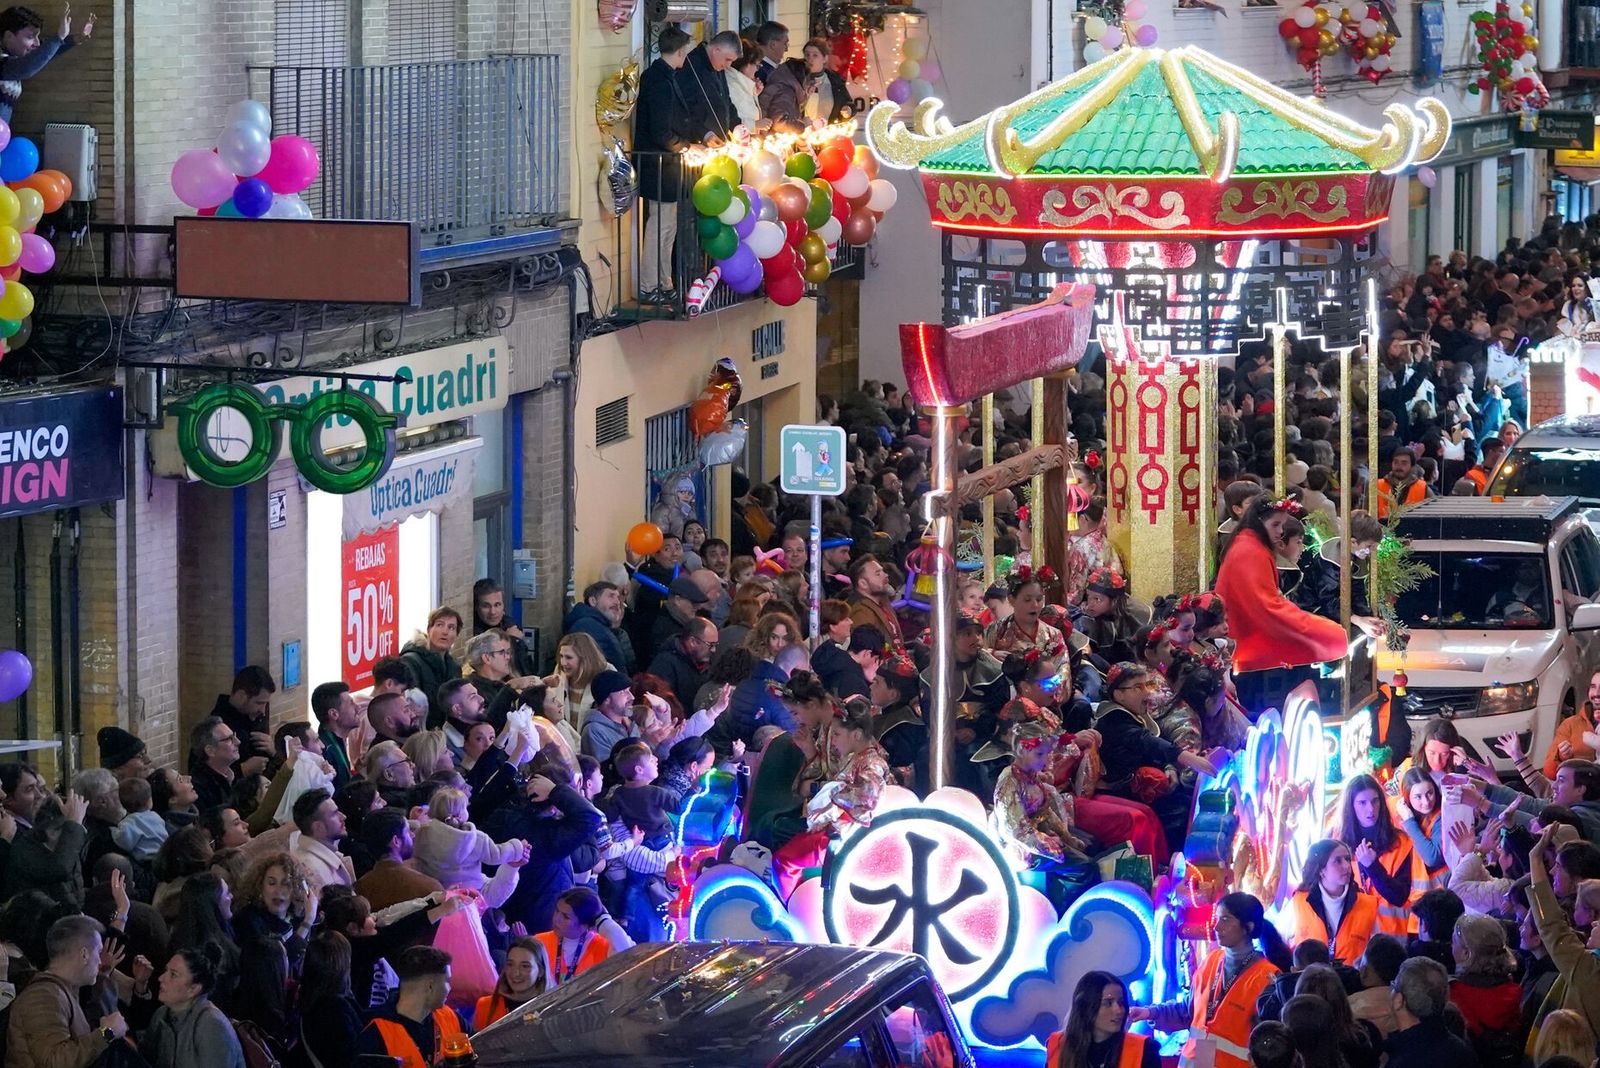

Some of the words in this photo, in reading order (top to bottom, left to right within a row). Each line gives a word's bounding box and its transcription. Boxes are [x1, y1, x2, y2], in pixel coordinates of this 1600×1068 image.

[392, 348, 496, 419] Cuadri
[0, 424, 69, 464] ENCO
[1, 458, 69, 504] IGN
[414, 459, 457, 503] Cuadri
[355, 542, 386, 571] REBAJAS
[379, 630, 393, 657] OFF
[849, 831, 988, 965] 水
